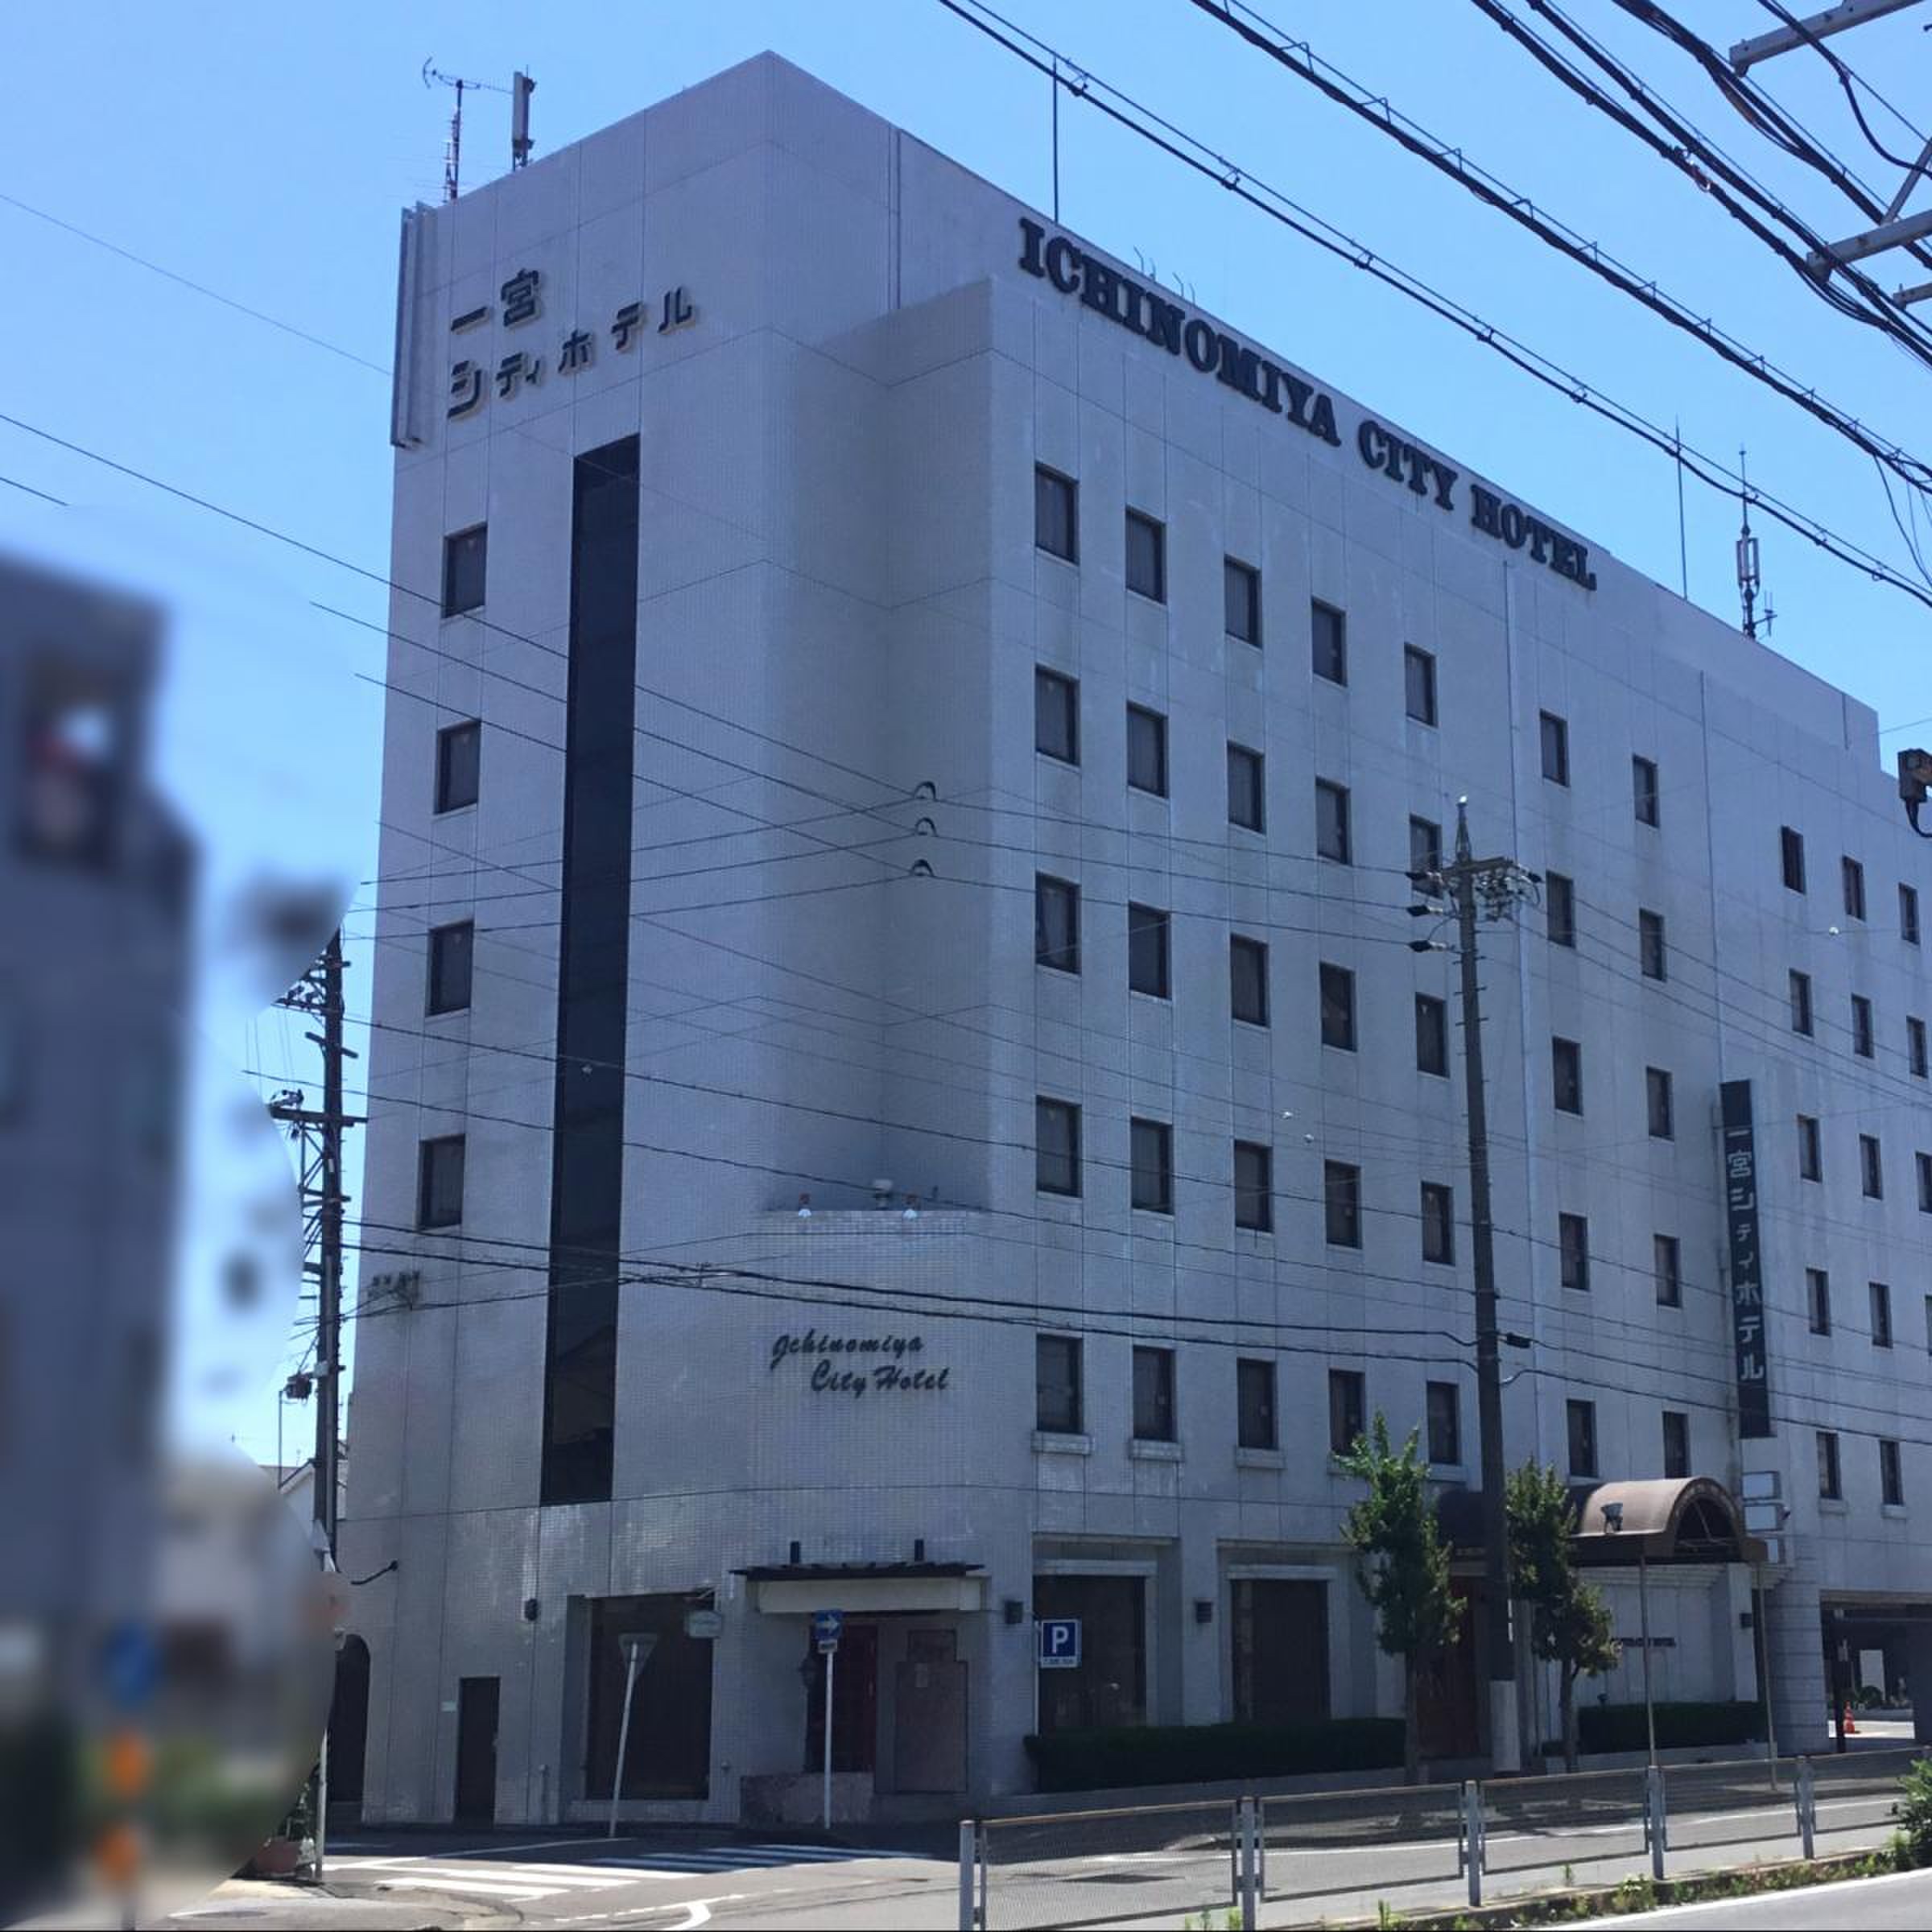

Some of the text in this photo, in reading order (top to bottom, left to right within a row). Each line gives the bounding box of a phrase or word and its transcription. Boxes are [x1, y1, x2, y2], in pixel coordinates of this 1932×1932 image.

[451, 268, 540, 331] 一宮
[1018, 217, 1597, 591] ICHINOMIYA CITY HOTEL
[1728, 1129, 1764, 1381] 一宮シティホテル
[770, 1328, 923, 1370] Ichinomiya
[811, 1359, 950, 1397] City Hotel
[1052, 1626, 1068, 1653] P
